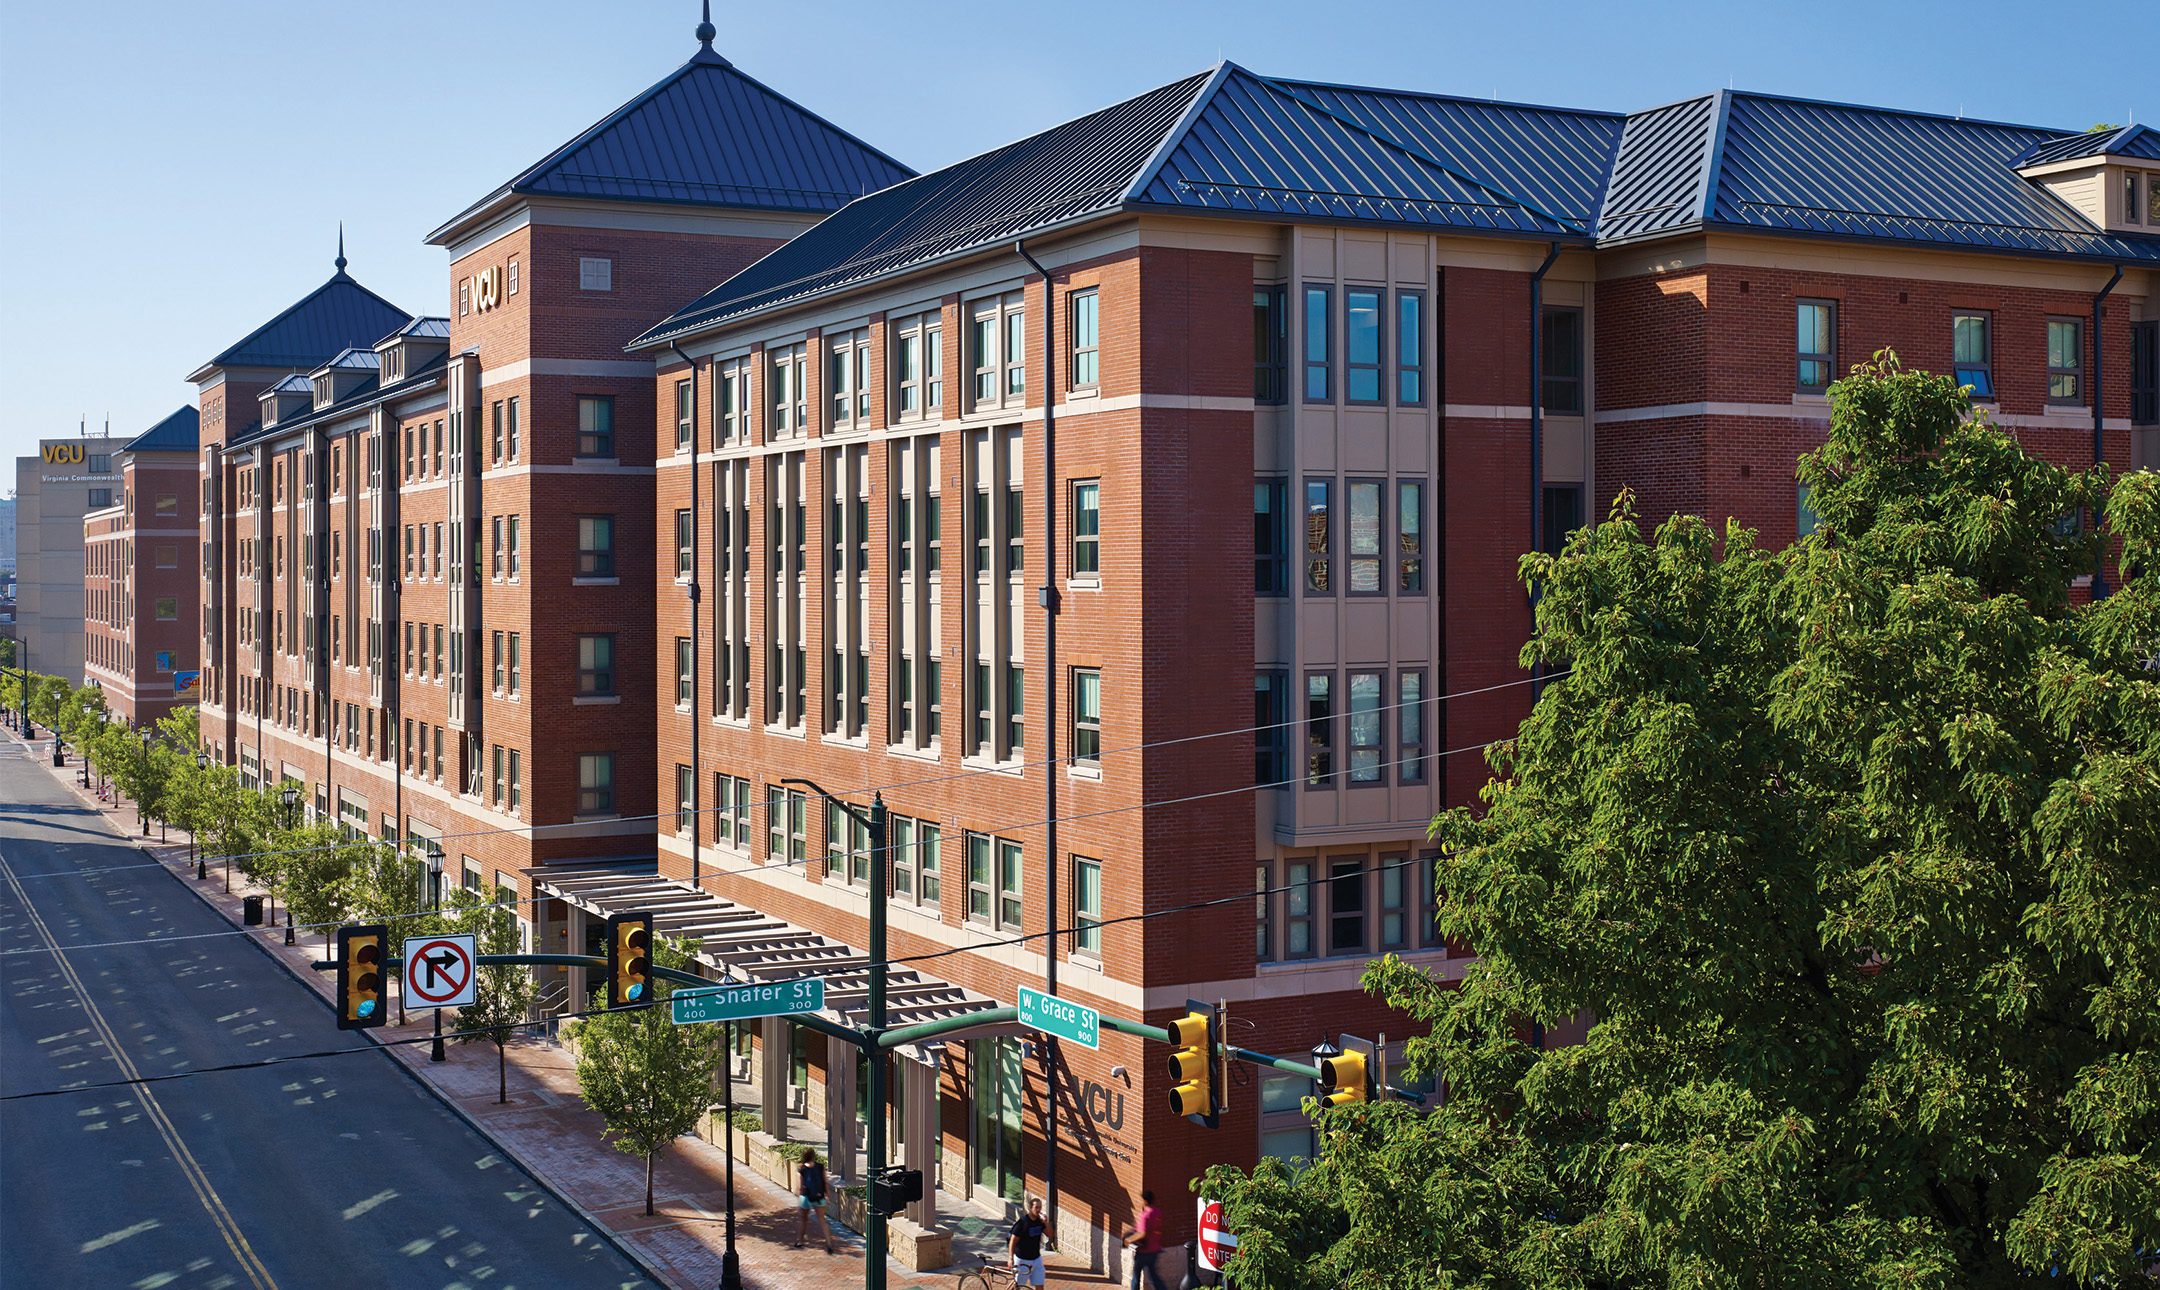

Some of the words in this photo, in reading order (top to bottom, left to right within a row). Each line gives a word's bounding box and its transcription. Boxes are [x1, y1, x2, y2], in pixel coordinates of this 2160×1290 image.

[471, 265, 499, 312] VCU
[41, 445, 84, 464] VCU
[683, 992, 703, 1008] N.
[715, 986, 782, 1005] Shafer
[793, 982, 812, 998] St
[789, 1001, 812, 1010] 300
[1022, 993, 1035, 1010] W.
[1041, 997, 1075, 1023] Grace
[1081, 1010, 1094, 1030] St
[684, 1010, 706, 1019] 400
[1021, 1011, 1033, 1022] 800
[1078, 1030, 1092, 1043] 900
[1072, 1074, 1124, 1131] VCU
[1206, 1211, 1218, 1224] DO
